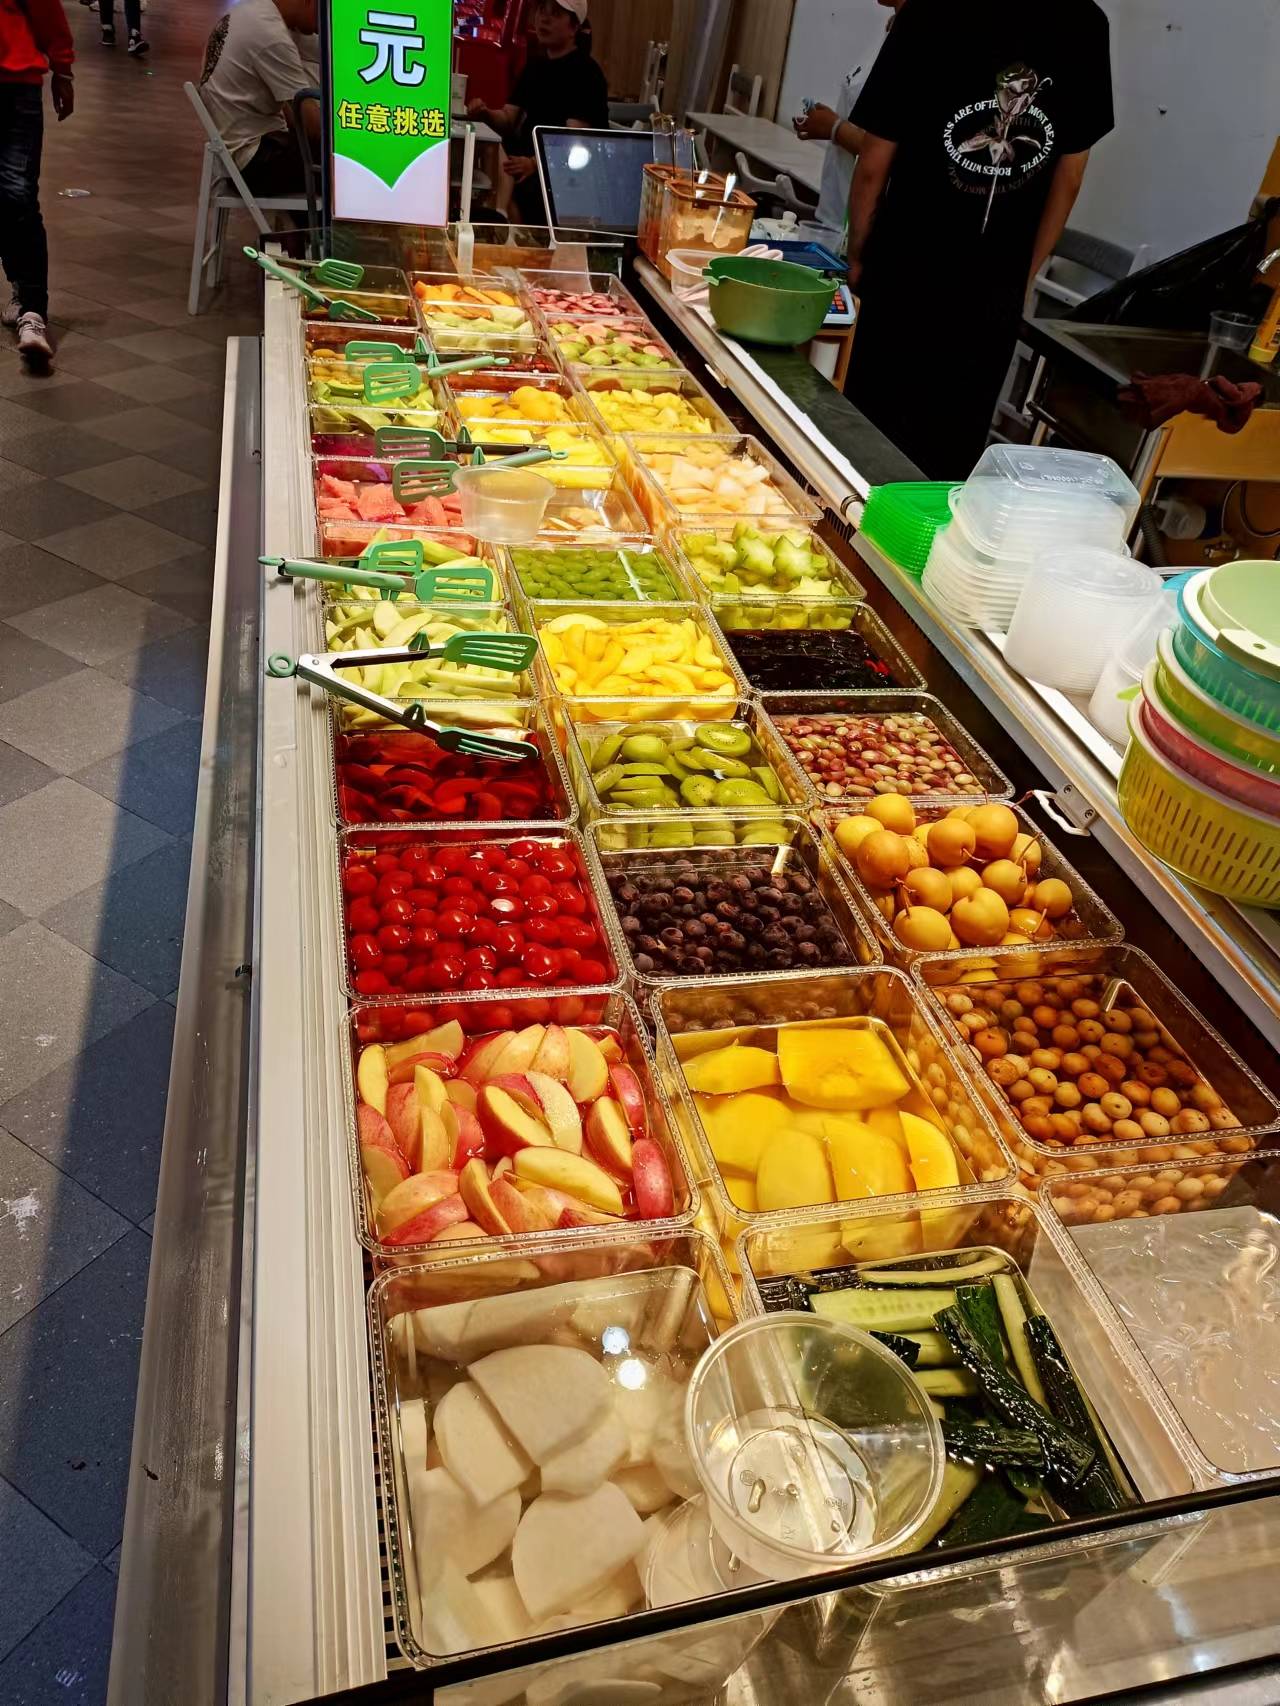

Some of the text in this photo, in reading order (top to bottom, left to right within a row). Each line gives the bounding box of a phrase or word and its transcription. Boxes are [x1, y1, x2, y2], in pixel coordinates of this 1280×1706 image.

[359, 10, 426, 87] 元
[338, 99, 446, 137] 任意挑选
[954, 104, 974, 124] ARE
[974, 99, 999, 112] OFTE
[1027, 104, 1049, 125] MOST
[943, 120, 963, 164] THORNS
[1019, 123, 1056, 174] BEAUTIFUL
[961, 157, 983, 174] WITH
